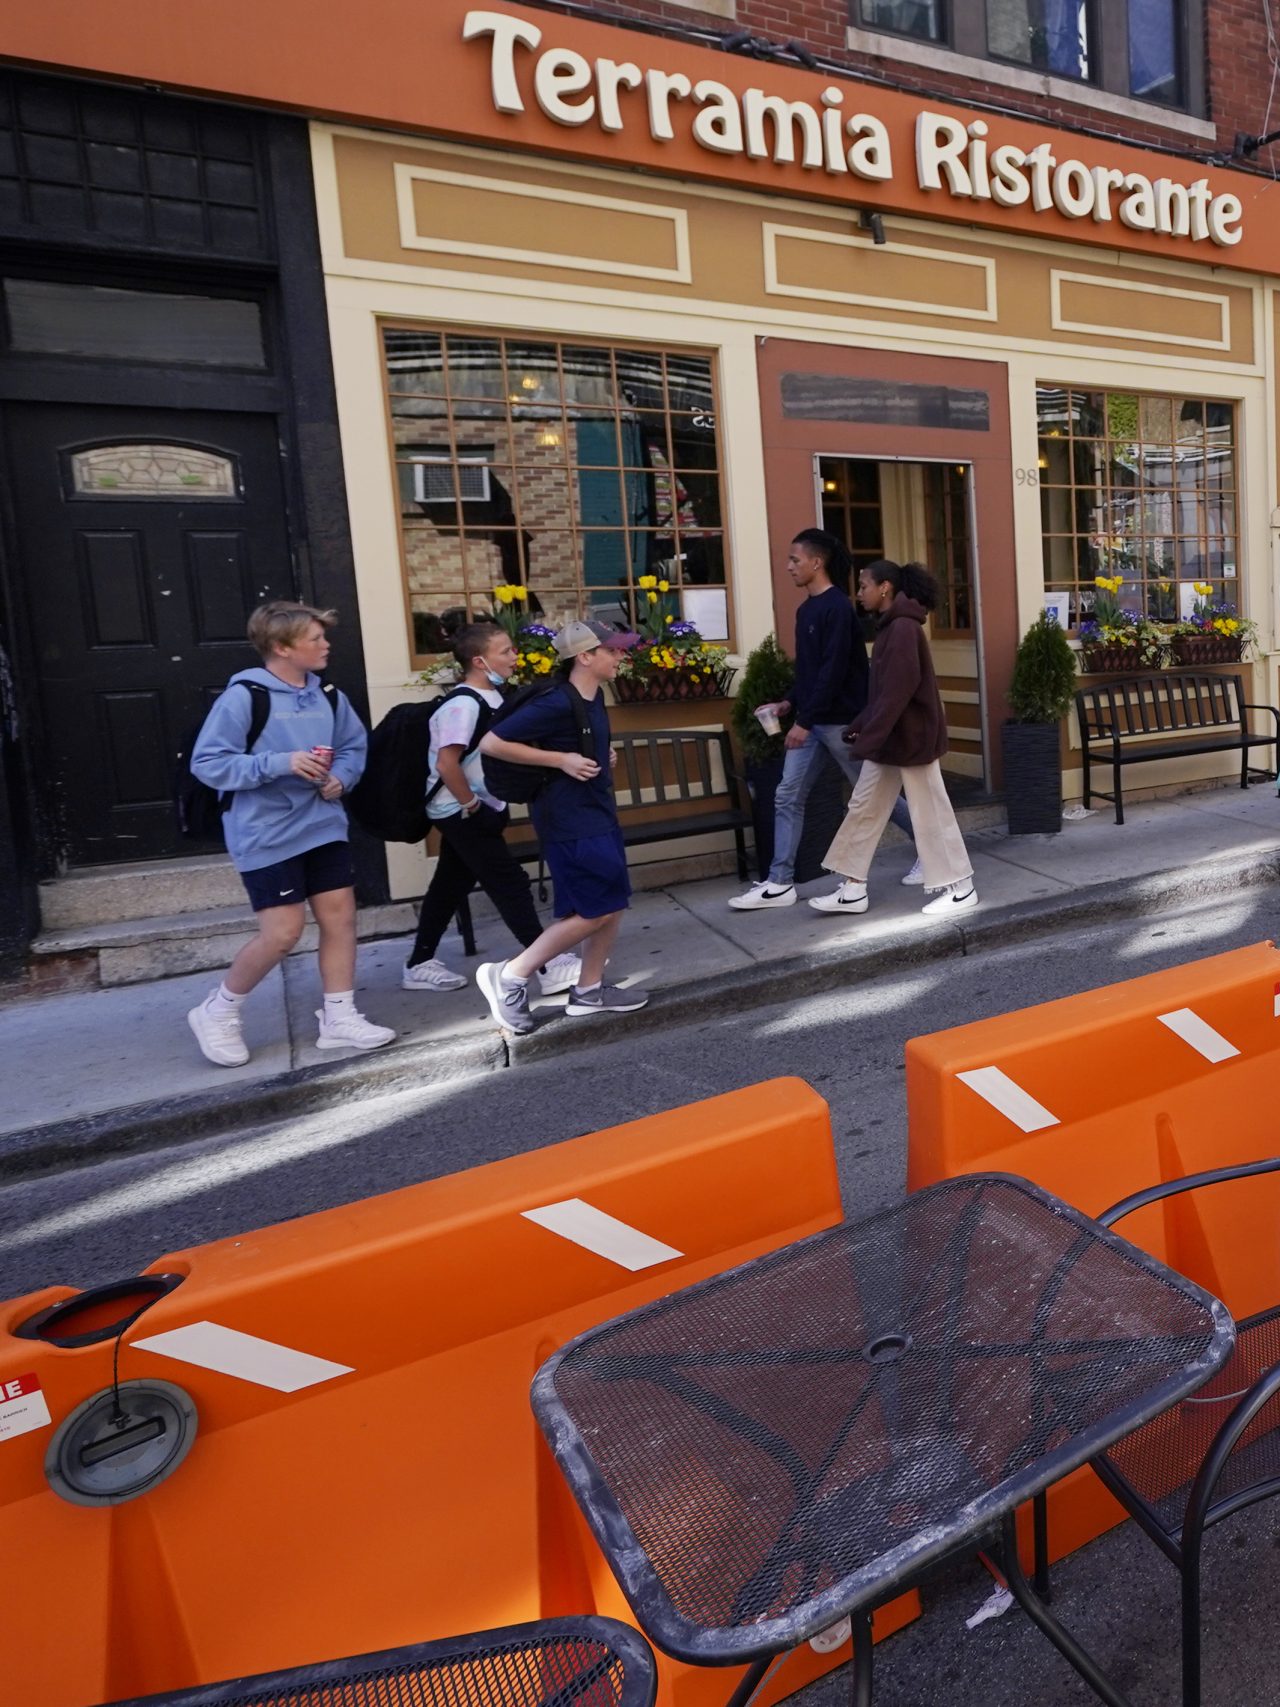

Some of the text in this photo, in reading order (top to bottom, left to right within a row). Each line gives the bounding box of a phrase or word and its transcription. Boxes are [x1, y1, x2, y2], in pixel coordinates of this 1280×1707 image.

[461, 8, 1244, 249] Terramia Ristorante
[1014, 467, 1038, 487] 98
